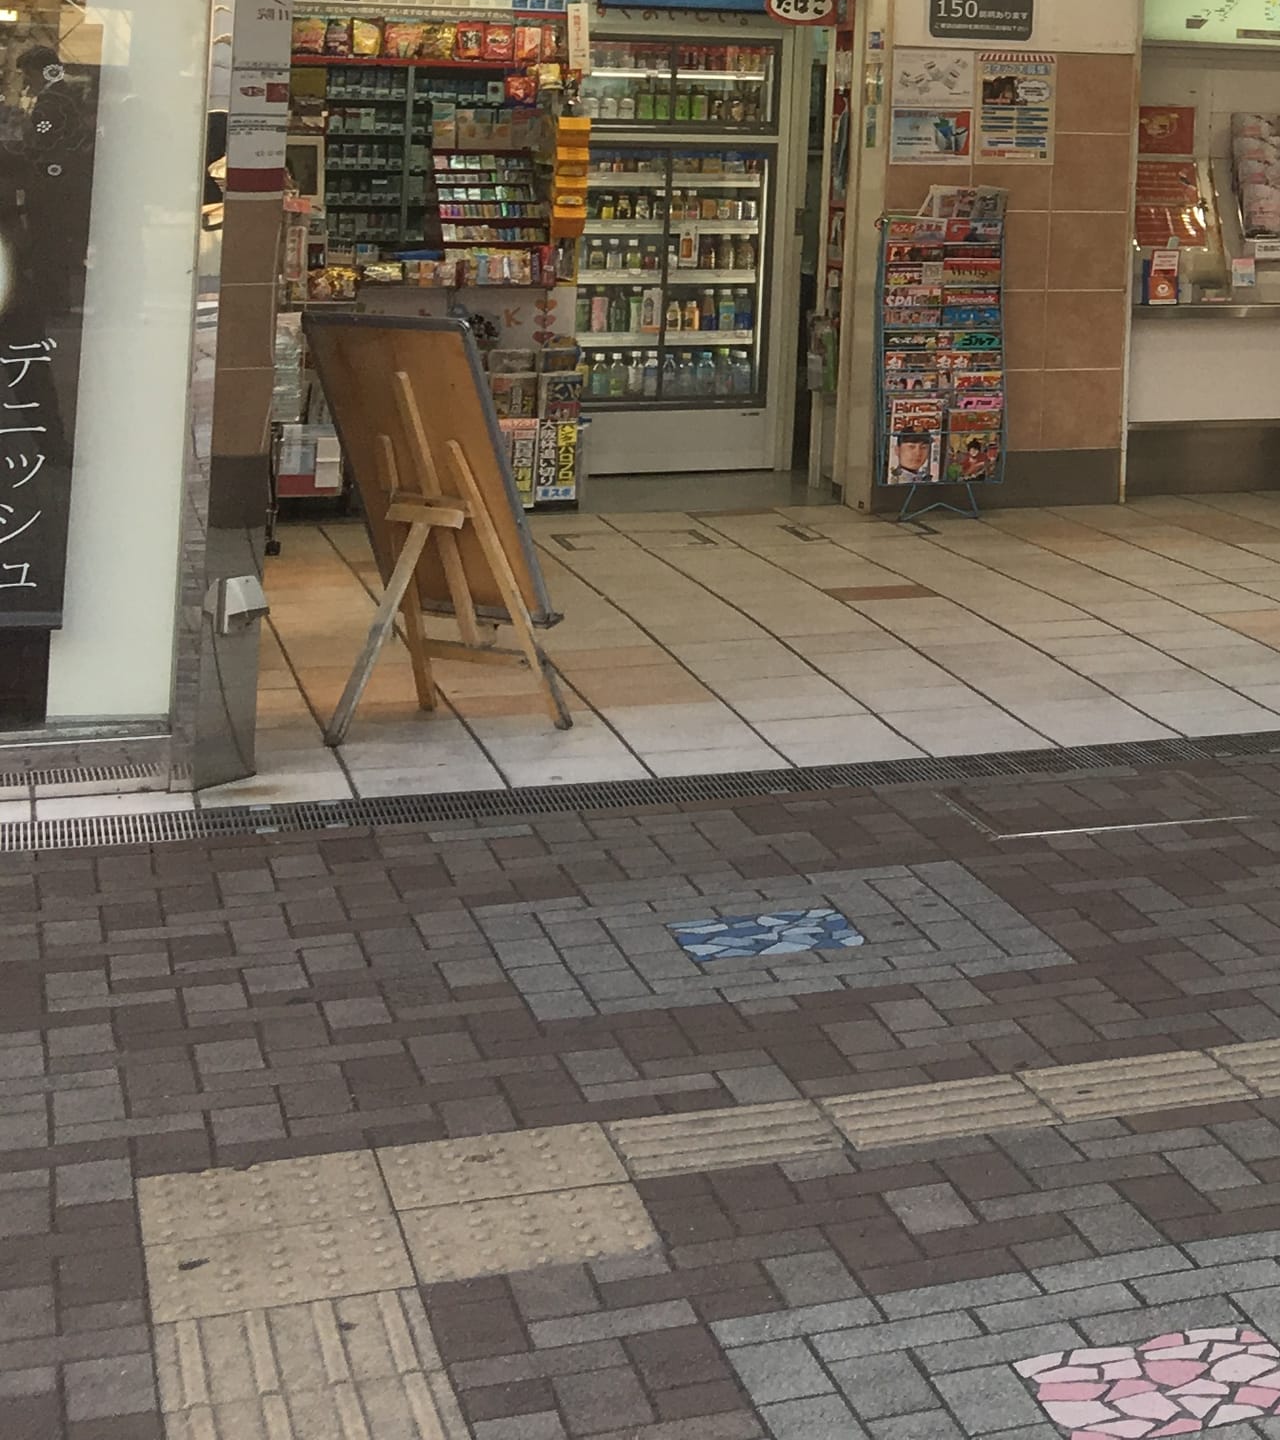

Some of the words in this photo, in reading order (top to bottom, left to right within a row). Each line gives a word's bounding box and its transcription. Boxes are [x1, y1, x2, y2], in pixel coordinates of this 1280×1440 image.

[0, 338, 58, 588] デニッシュ
